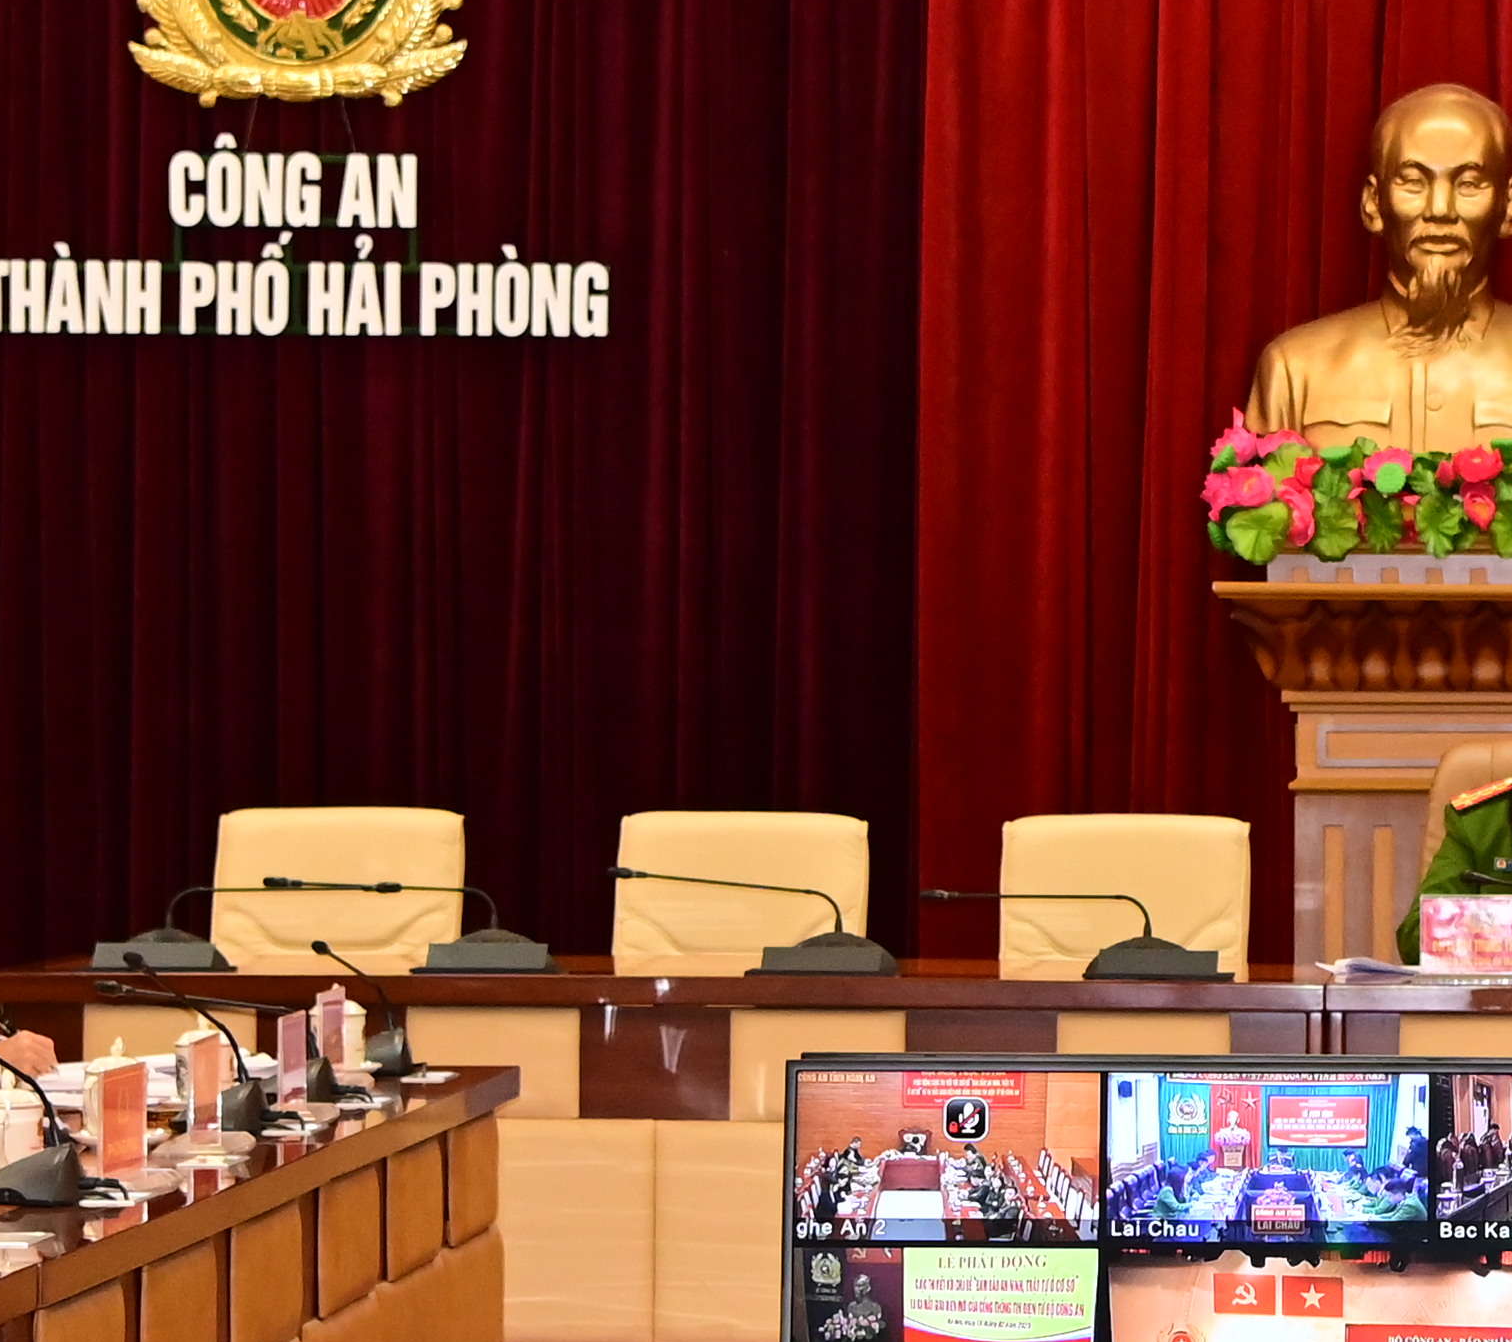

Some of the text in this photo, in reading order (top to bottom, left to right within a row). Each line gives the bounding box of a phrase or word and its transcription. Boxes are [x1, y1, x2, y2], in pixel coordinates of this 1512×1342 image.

[168, 132, 418, 229] CÔNG AN
[178, 232, 293, 337] PHỐ
[307, 233, 402, 337] HẢI
[419, 243, 609, 338] PHÒNG
[840, 1219, 867, 1236] An
[874, 1219, 887, 1236] 2
[1111, 1218, 1199, 1237] Lai Chau
[1439, 1221, 1478, 1239] Bac
